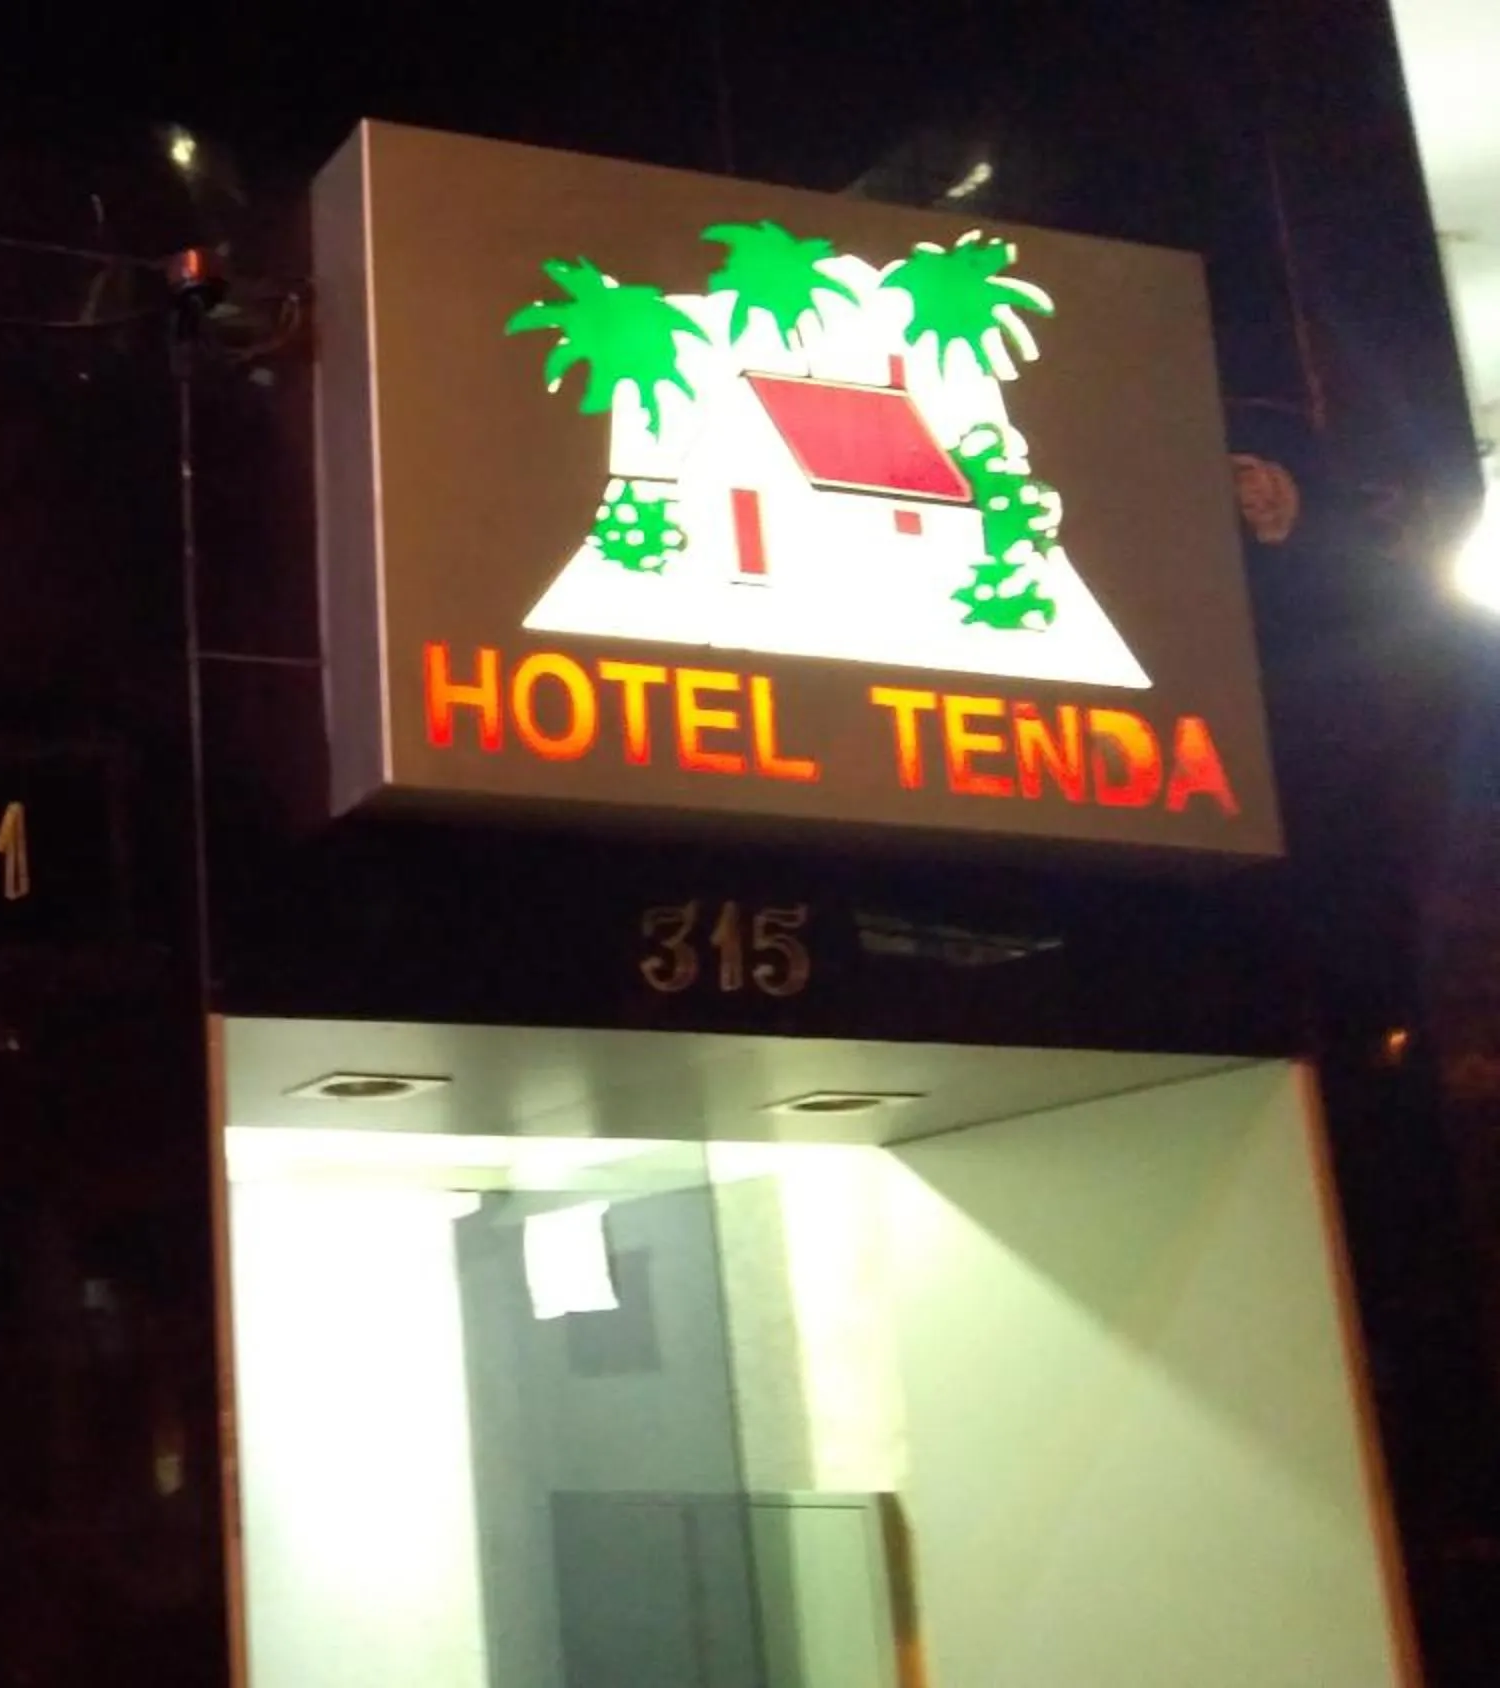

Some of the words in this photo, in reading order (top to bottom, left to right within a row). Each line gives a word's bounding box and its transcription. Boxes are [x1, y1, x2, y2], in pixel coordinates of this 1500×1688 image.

[422, 641, 821, 784] HOTEL
[869, 686, 1240, 817] TENDA
[640, 899, 811, 996] 315
